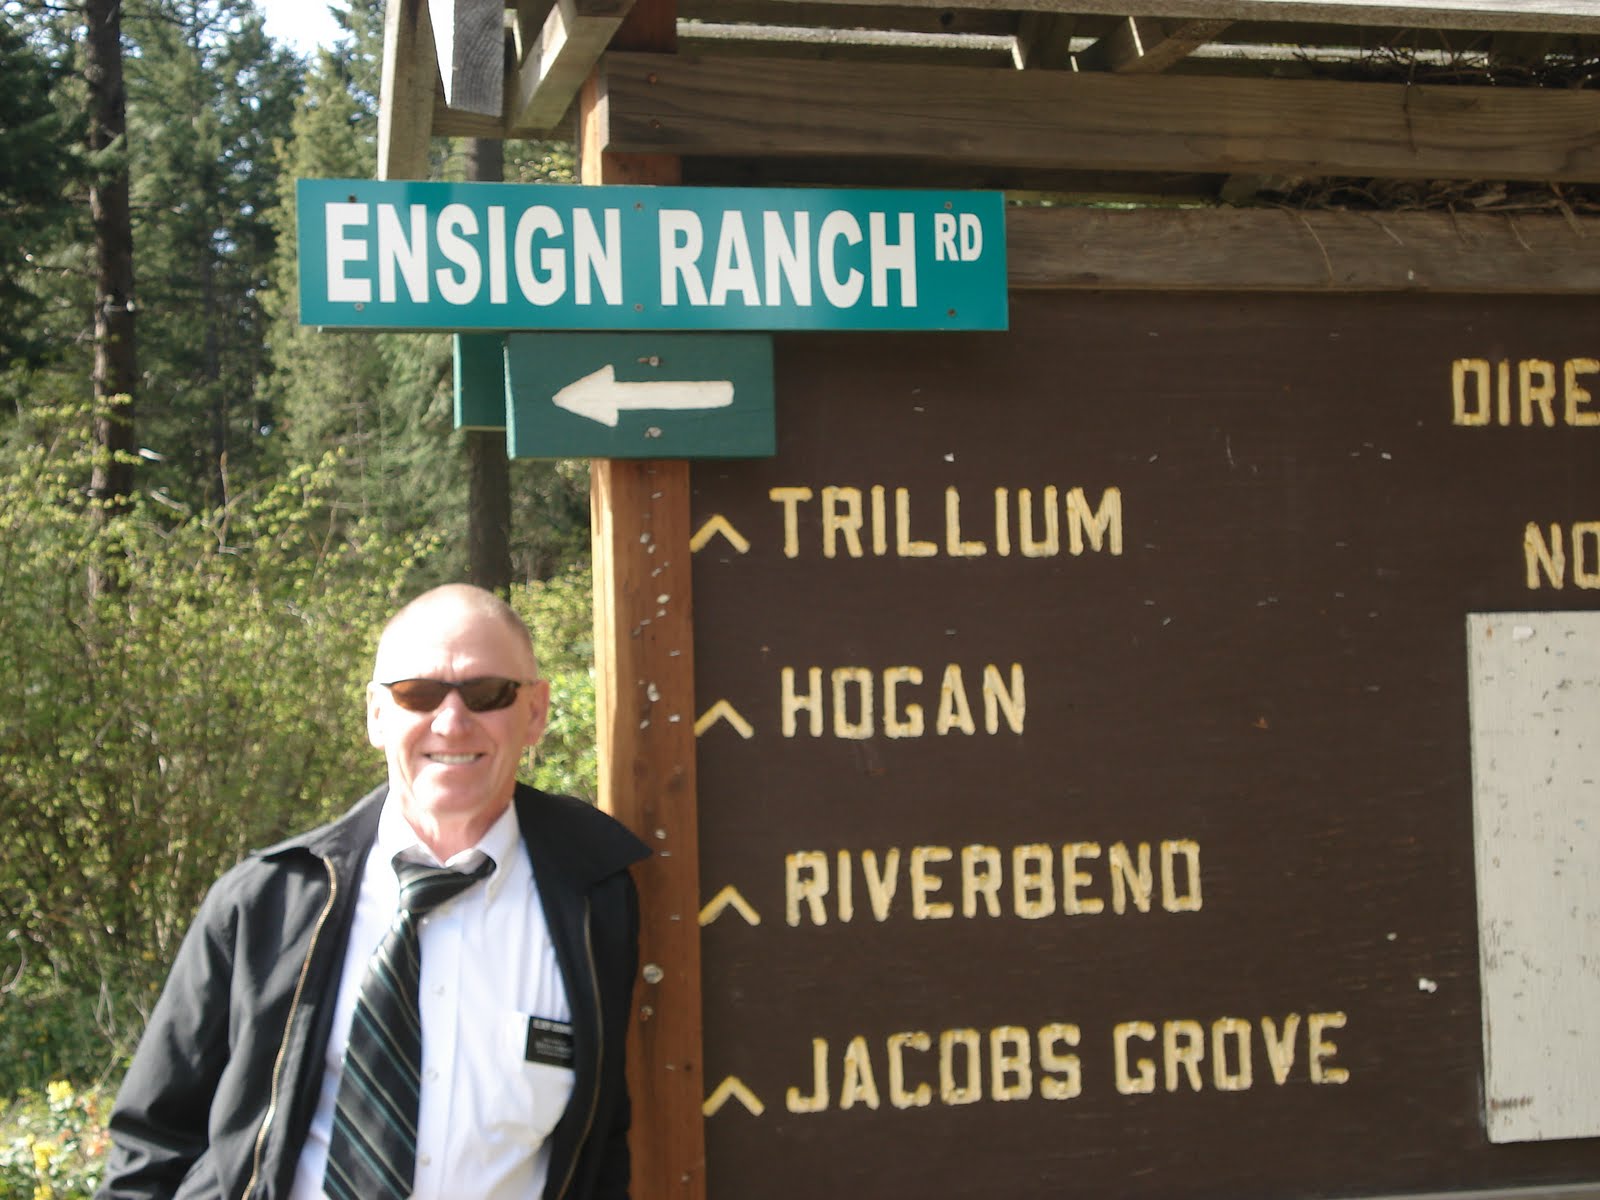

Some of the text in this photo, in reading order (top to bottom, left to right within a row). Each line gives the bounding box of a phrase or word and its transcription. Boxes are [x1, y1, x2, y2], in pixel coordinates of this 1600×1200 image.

[326, 203, 982, 307] ENSIGN RANCH RD
[1451, 358, 1600, 427] DIRE
[769, 485, 1123, 558] TRILLIUM
[781, 663, 1026, 739] HOGAN
[785, 839, 1203, 926] RIVERBEND
[786, 1012, 1350, 1113] JACOBS GROVE
